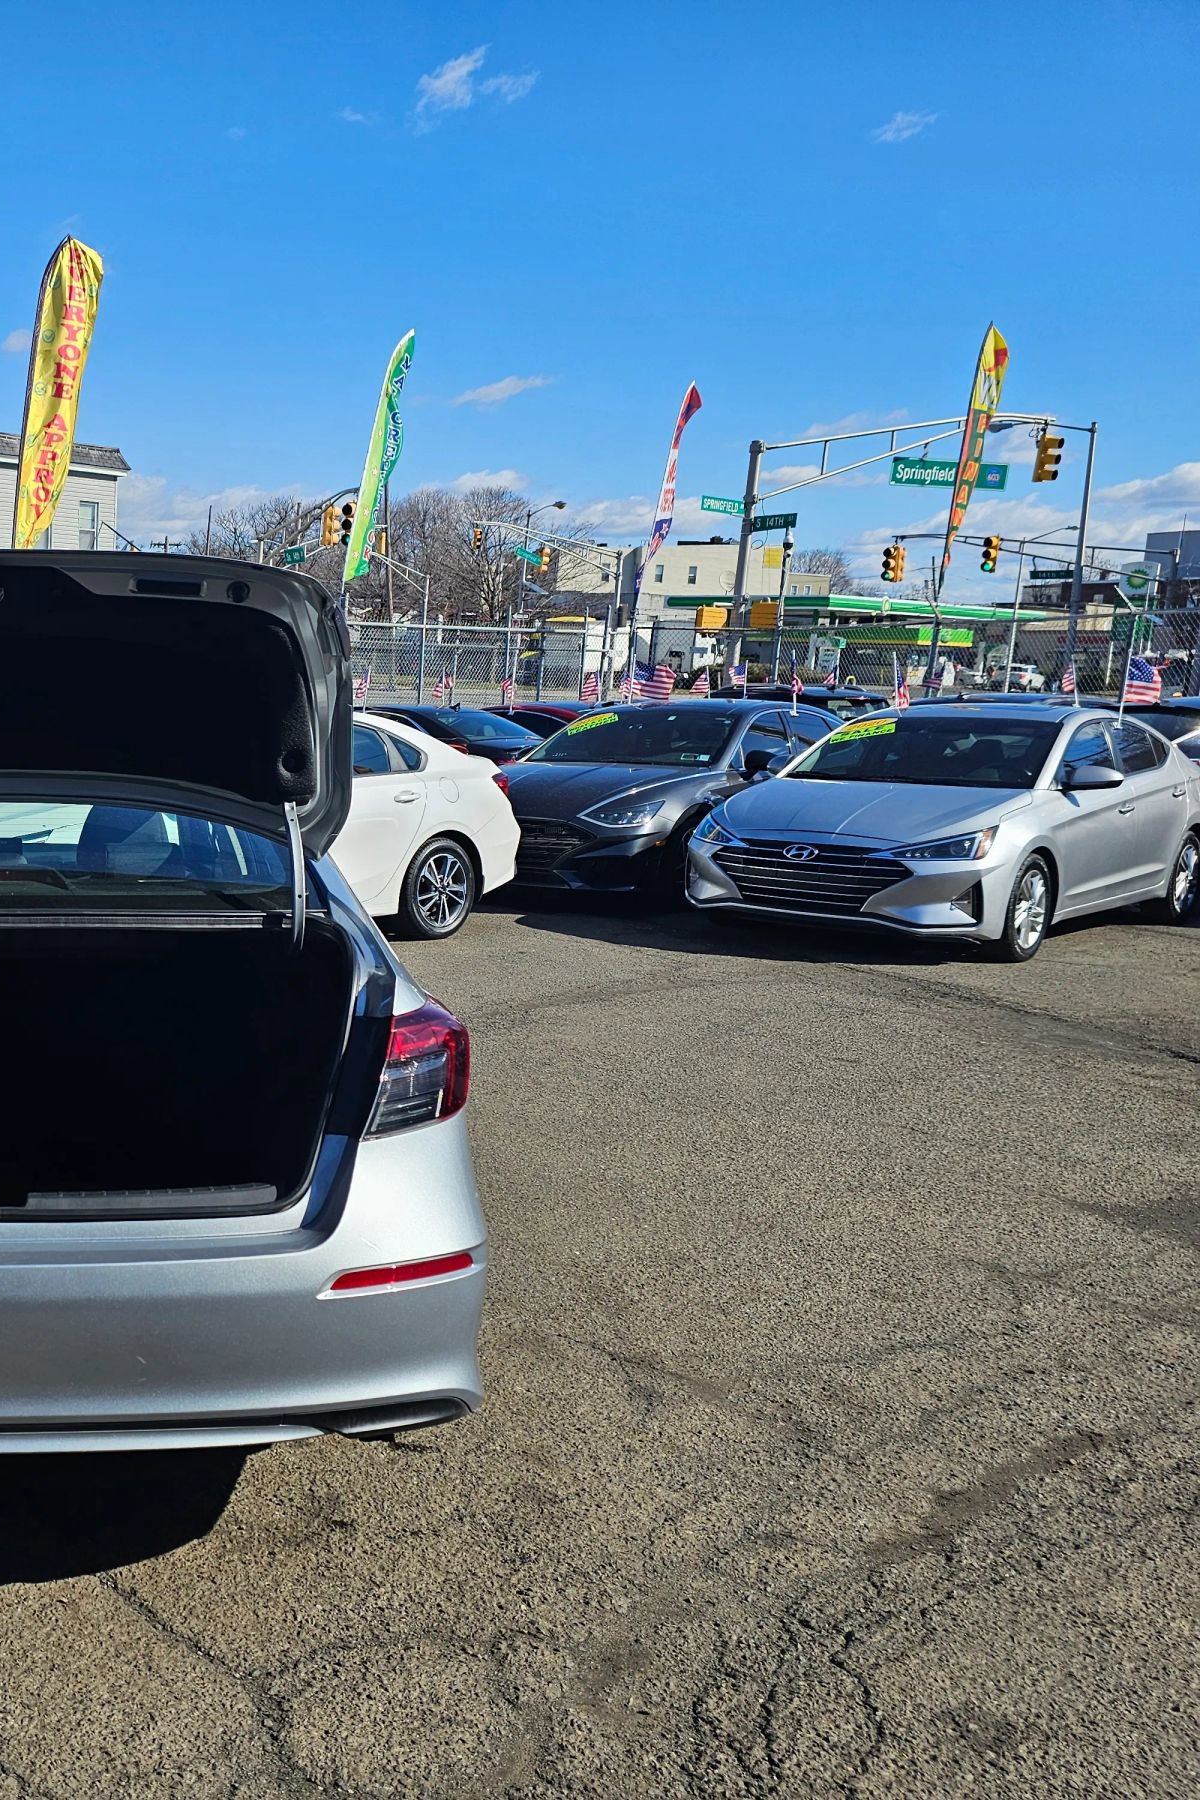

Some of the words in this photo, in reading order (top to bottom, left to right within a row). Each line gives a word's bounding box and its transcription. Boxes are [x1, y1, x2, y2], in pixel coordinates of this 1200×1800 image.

[29, 414, 68, 522] APPROV
[896, 464, 956, 485] Springfield
[703, 498, 739, 513] SPRINGFIELD
[756, 520, 761, 528] S
[766, 516, 785, 527] 14TH
